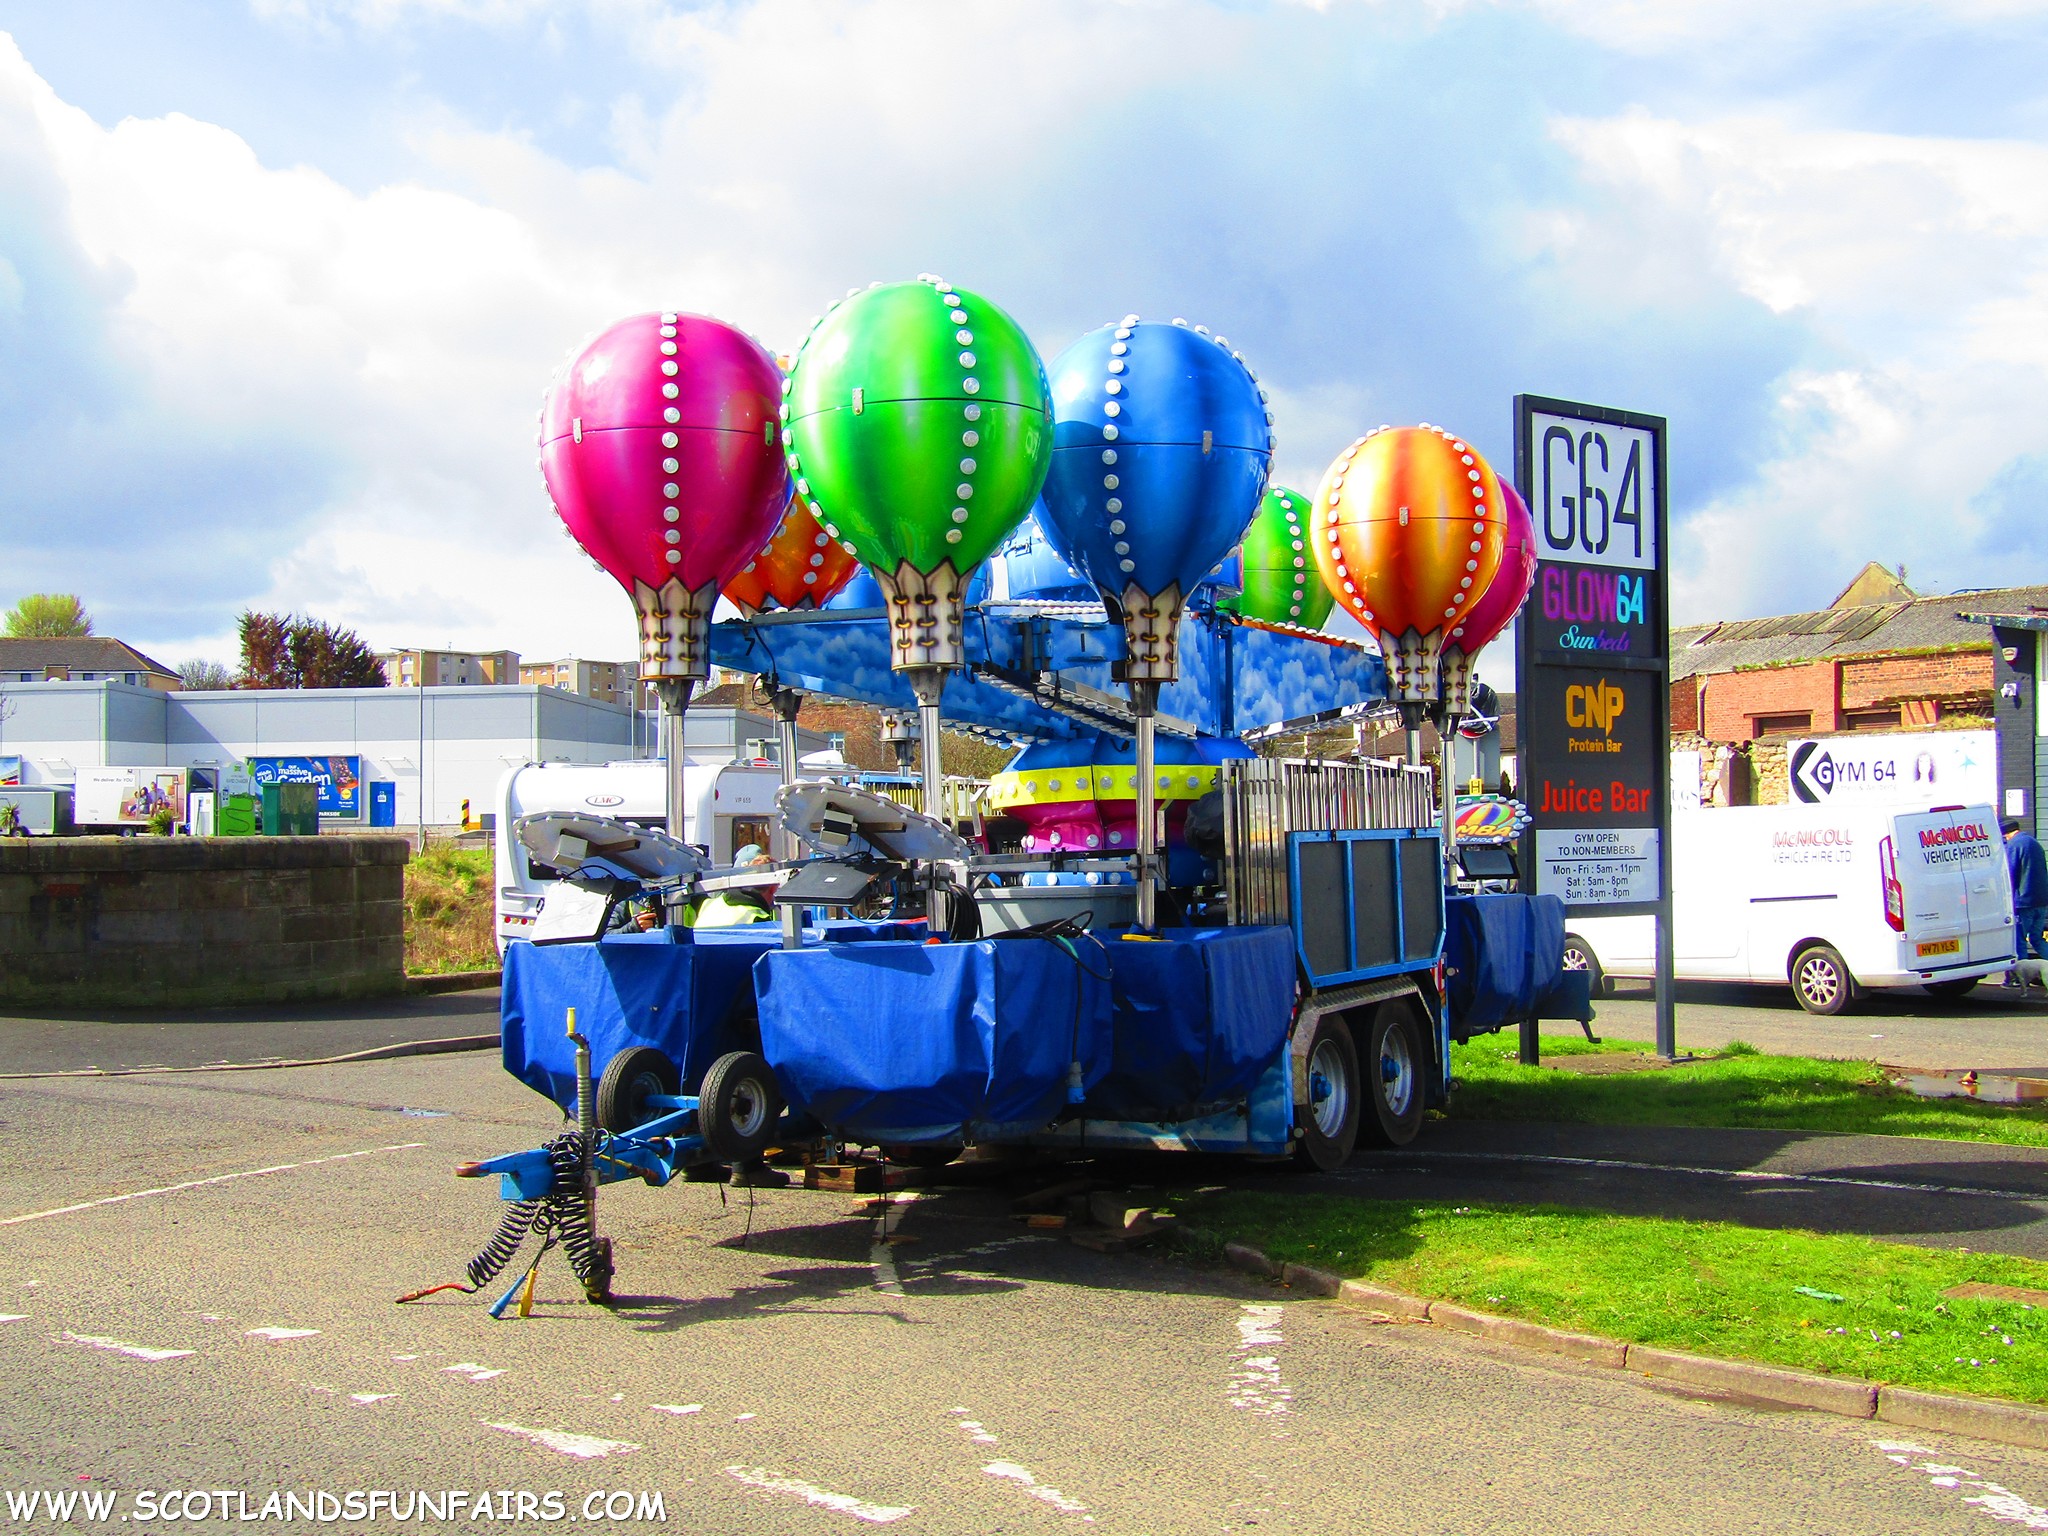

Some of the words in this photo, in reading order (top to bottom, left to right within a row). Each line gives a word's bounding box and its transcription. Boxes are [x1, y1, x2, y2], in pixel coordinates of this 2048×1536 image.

[1543, 425, 1642, 558] G64
[1543, 566, 1644, 625] GLOW64
[1559, 624, 1630, 651] Sunbeds
[744, 637, 756, 657] 7
[1565, 677, 1625, 737] CNP
[1568, 738, 1604, 754] Protein
[1606, 738, 1623, 753] Bar
[278, 766, 308, 776] massive
[1873, 760, 1896, 781] 64
[1471, 780, 1480, 794] H
[594, 796, 616, 804] LMC
[1540, 780, 1603, 813] Juice
[1610, 780, 1651, 813] Bar
[1574, 833, 1595, 844] GYM
[1596, 833, 1620, 843] OPEN
[1772, 828, 1854, 848] McNICOLL
[1918, 823, 1989, 849] McNICOLL
[1558, 846, 1570, 856] TO
[1572, 845, 1636, 856] NON-MEMBERS
[1773, 851, 1809, 863] VEHICLE
[1811, 850, 1833, 863] HIRE
[1835, 850, 1852, 863] LTD
[1922, 848, 1958, 865] VEHICLE
[1958, 846, 1978, 860] HIRE
[1978, 844, 1991, 858] LTD
[1553, 865, 1571, 875] Mon
[1578, 865, 1589, 874] Fri
[1596, 865, 1613, 874] 5am
[1620, 864, 1641, 876] 11pm
[1566, 877, 1581, 886] Sat
[1587, 876, 1604, 886] 5am
[1611, 876, 1629, 887] 8pm
[1565, 889, 1581, 899] Sun
[1589, 888, 1606, 898] 8am
[1613, 888, 1630, 900] 8pm
